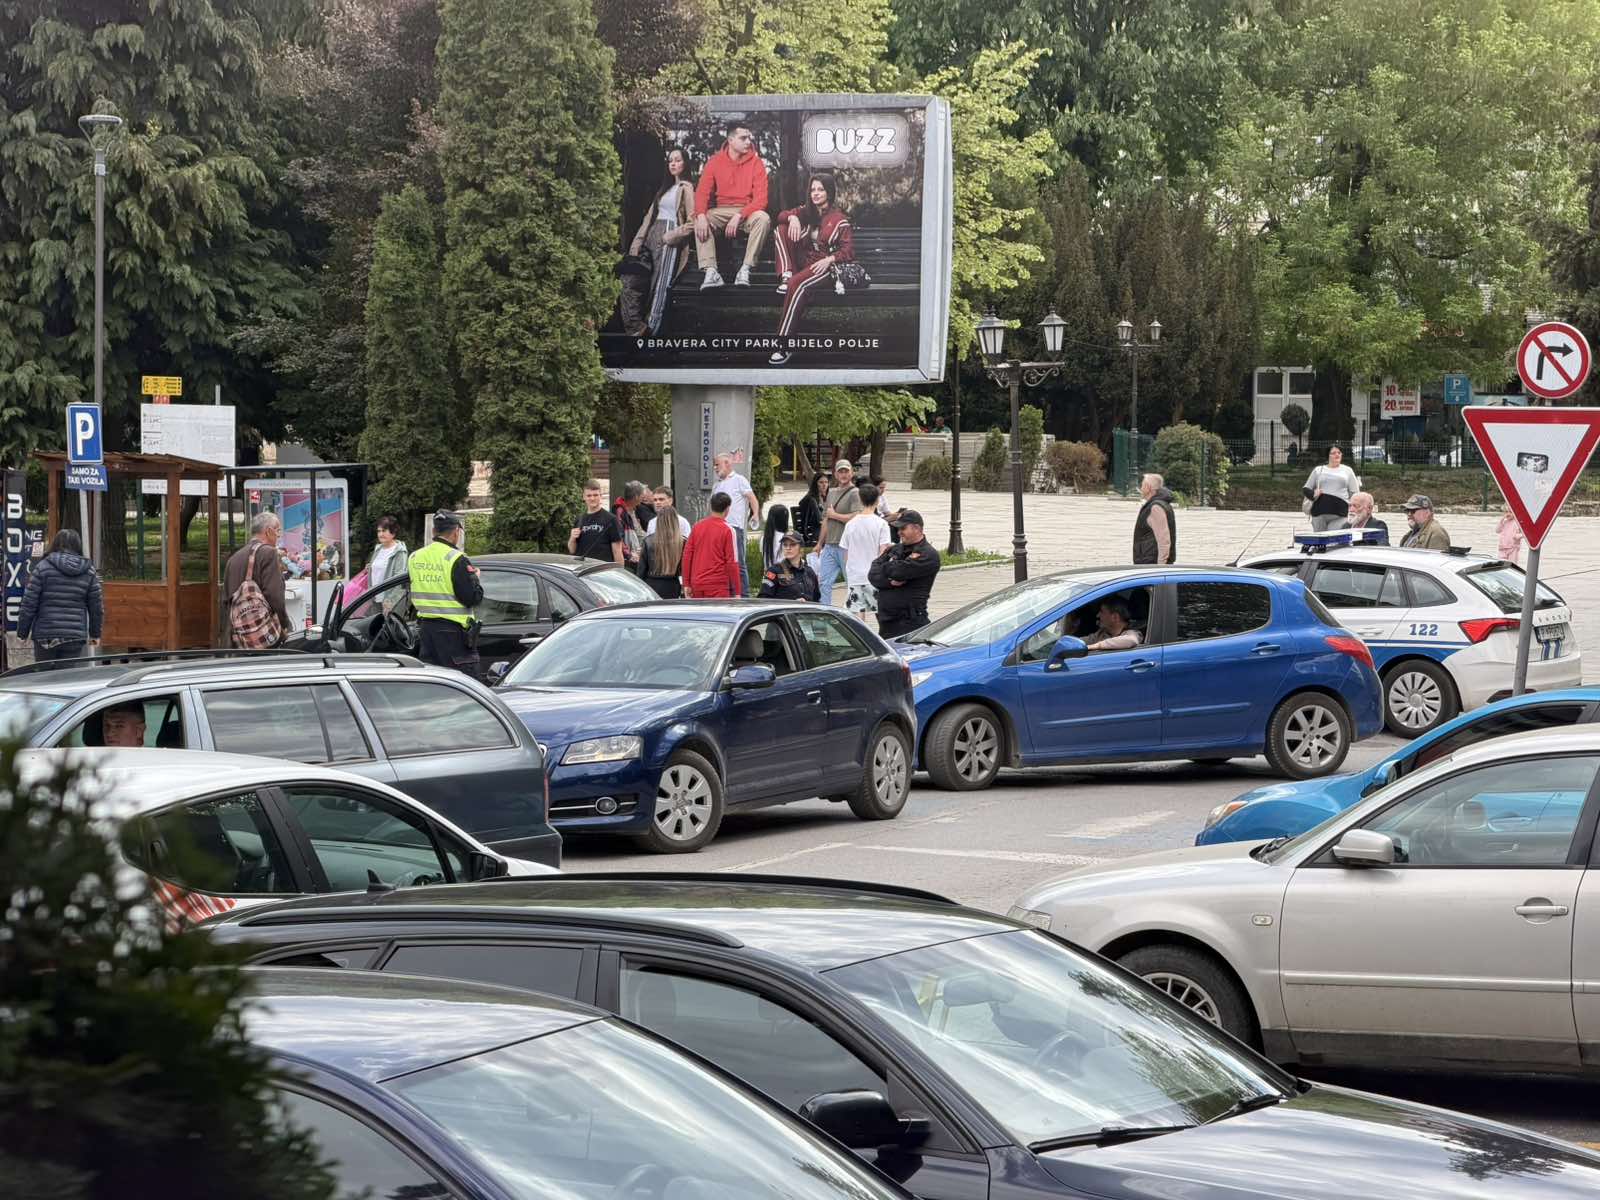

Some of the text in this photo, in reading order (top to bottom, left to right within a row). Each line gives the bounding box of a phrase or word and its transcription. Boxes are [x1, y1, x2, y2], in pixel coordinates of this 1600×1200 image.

[816, 128, 896, 154] BUZZ
[647, 338, 879, 349] BRAVERA CITY PARK, BIJELO POLJE
[75, 411, 95, 456] P
[703, 407, 711, 486] METROPOLIS
[72, 467, 99, 476] SAMO ZA
[68, 475, 105, 486] TAXI VOZILA
[1408, 623, 1439, 637] 122
